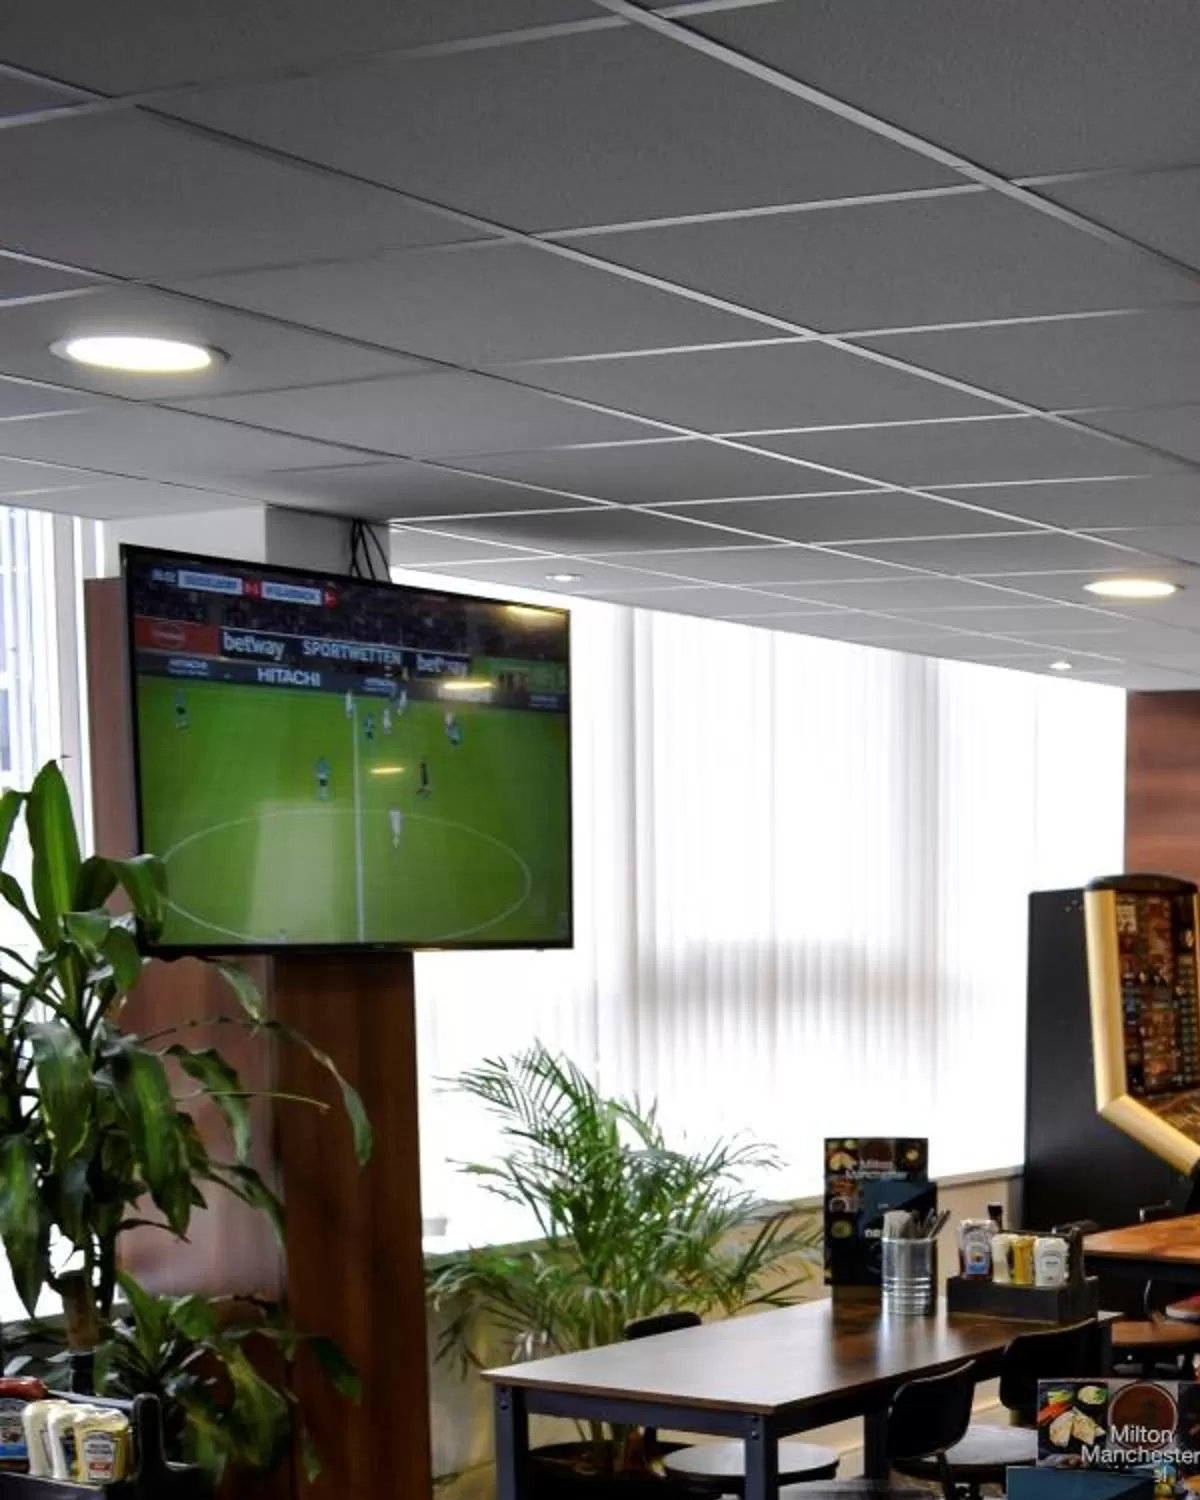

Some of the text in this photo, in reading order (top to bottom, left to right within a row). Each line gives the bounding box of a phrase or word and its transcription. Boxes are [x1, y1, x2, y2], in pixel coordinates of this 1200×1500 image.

[223, 632, 402, 665] betway SPORTWETTEN
[257, 667, 321, 687] HITACHI
[1110, 1424, 1173, 1443] Milton
